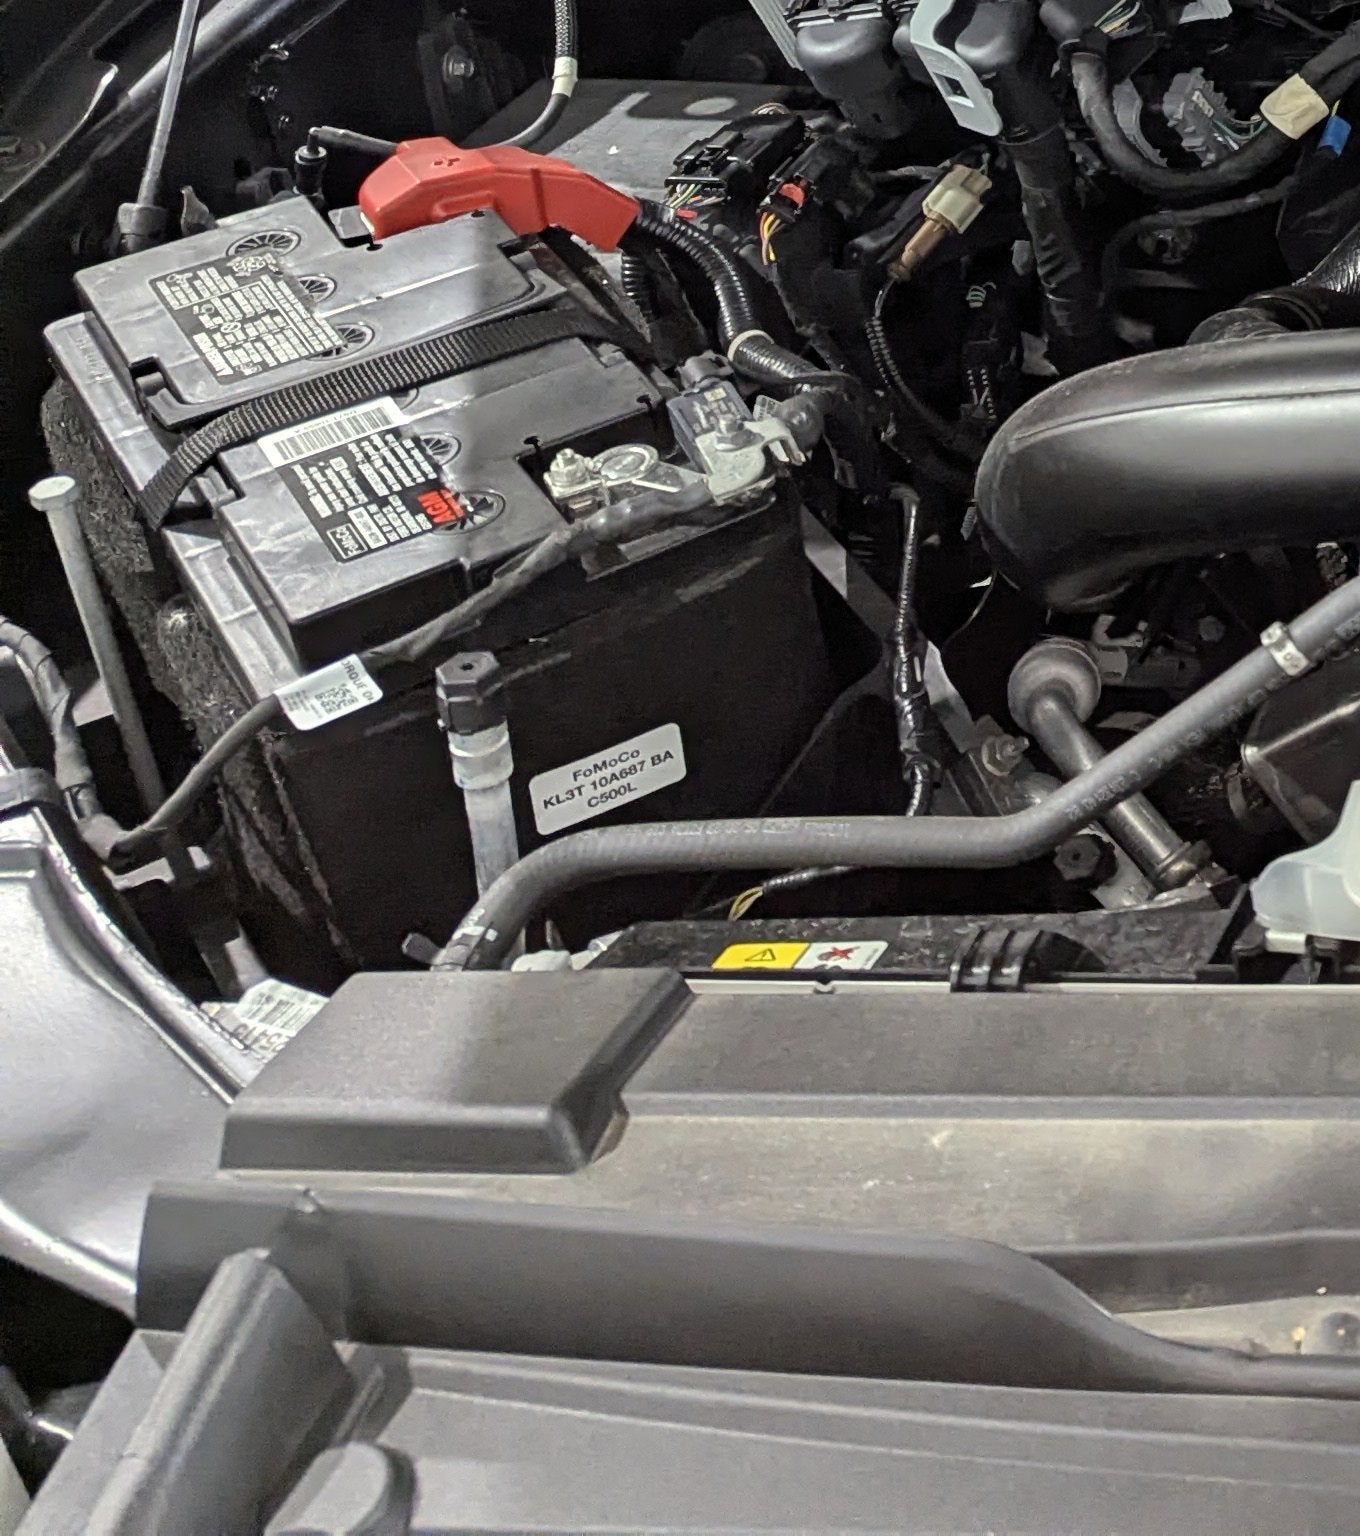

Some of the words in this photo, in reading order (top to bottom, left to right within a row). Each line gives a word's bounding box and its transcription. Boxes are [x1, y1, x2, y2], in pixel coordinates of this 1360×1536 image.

[416, 489, 456, 526] AGM
[542, 784, 587, 810] KL3T
[590, 760, 646, 791] 10A687
[650, 750, 675, 767] BA
[572, 748, 641, 783] FoMoCo
[586, 781, 639, 809] C500L
